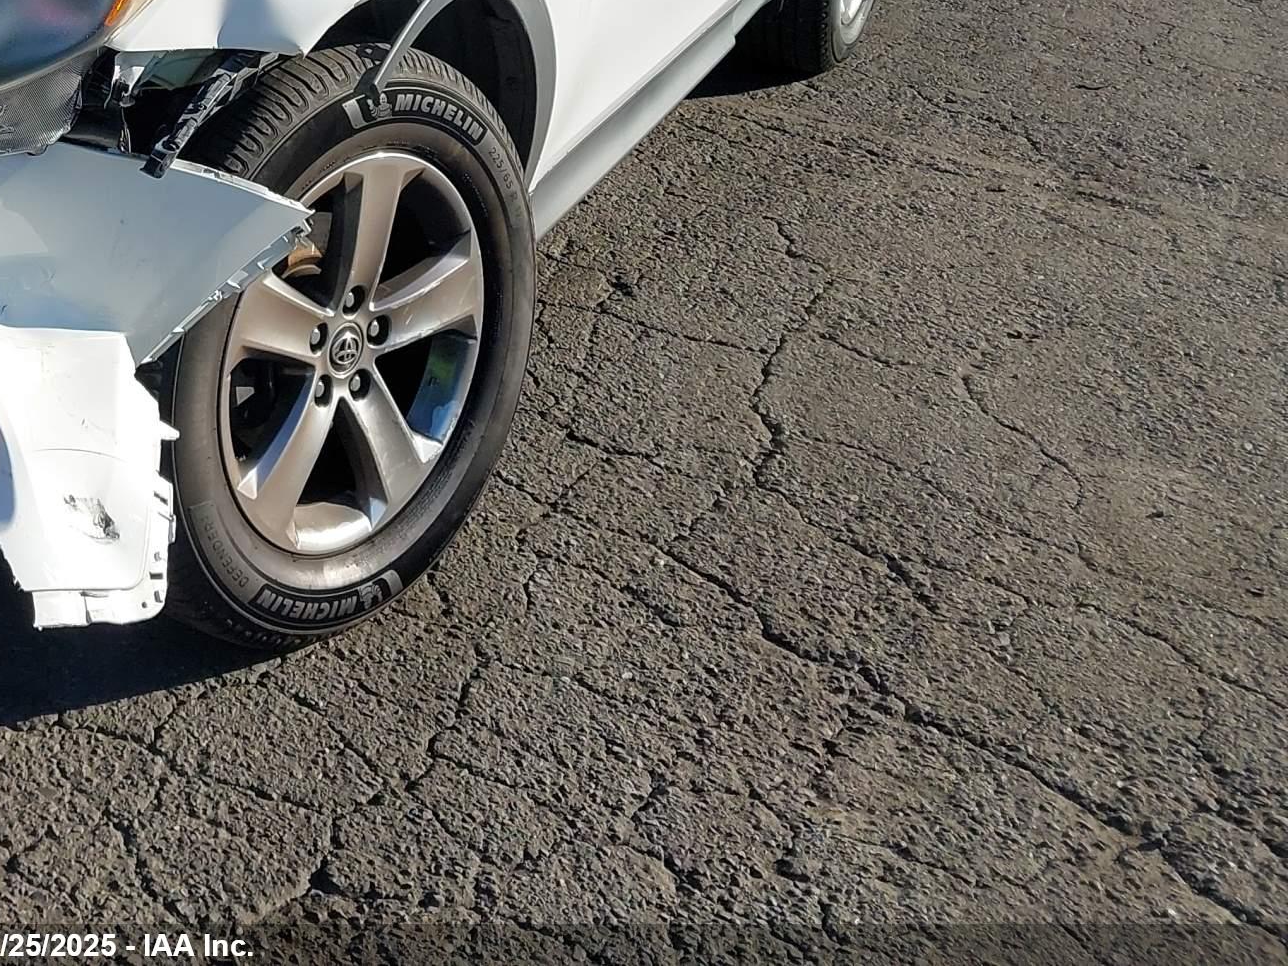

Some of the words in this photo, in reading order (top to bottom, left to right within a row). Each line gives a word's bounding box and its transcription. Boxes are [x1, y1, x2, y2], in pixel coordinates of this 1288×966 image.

[394, 93, 484, 141] MICHELIN
[488, 146, 514, 191] 225/65
[256, 588, 358, 620] MICHELIN
